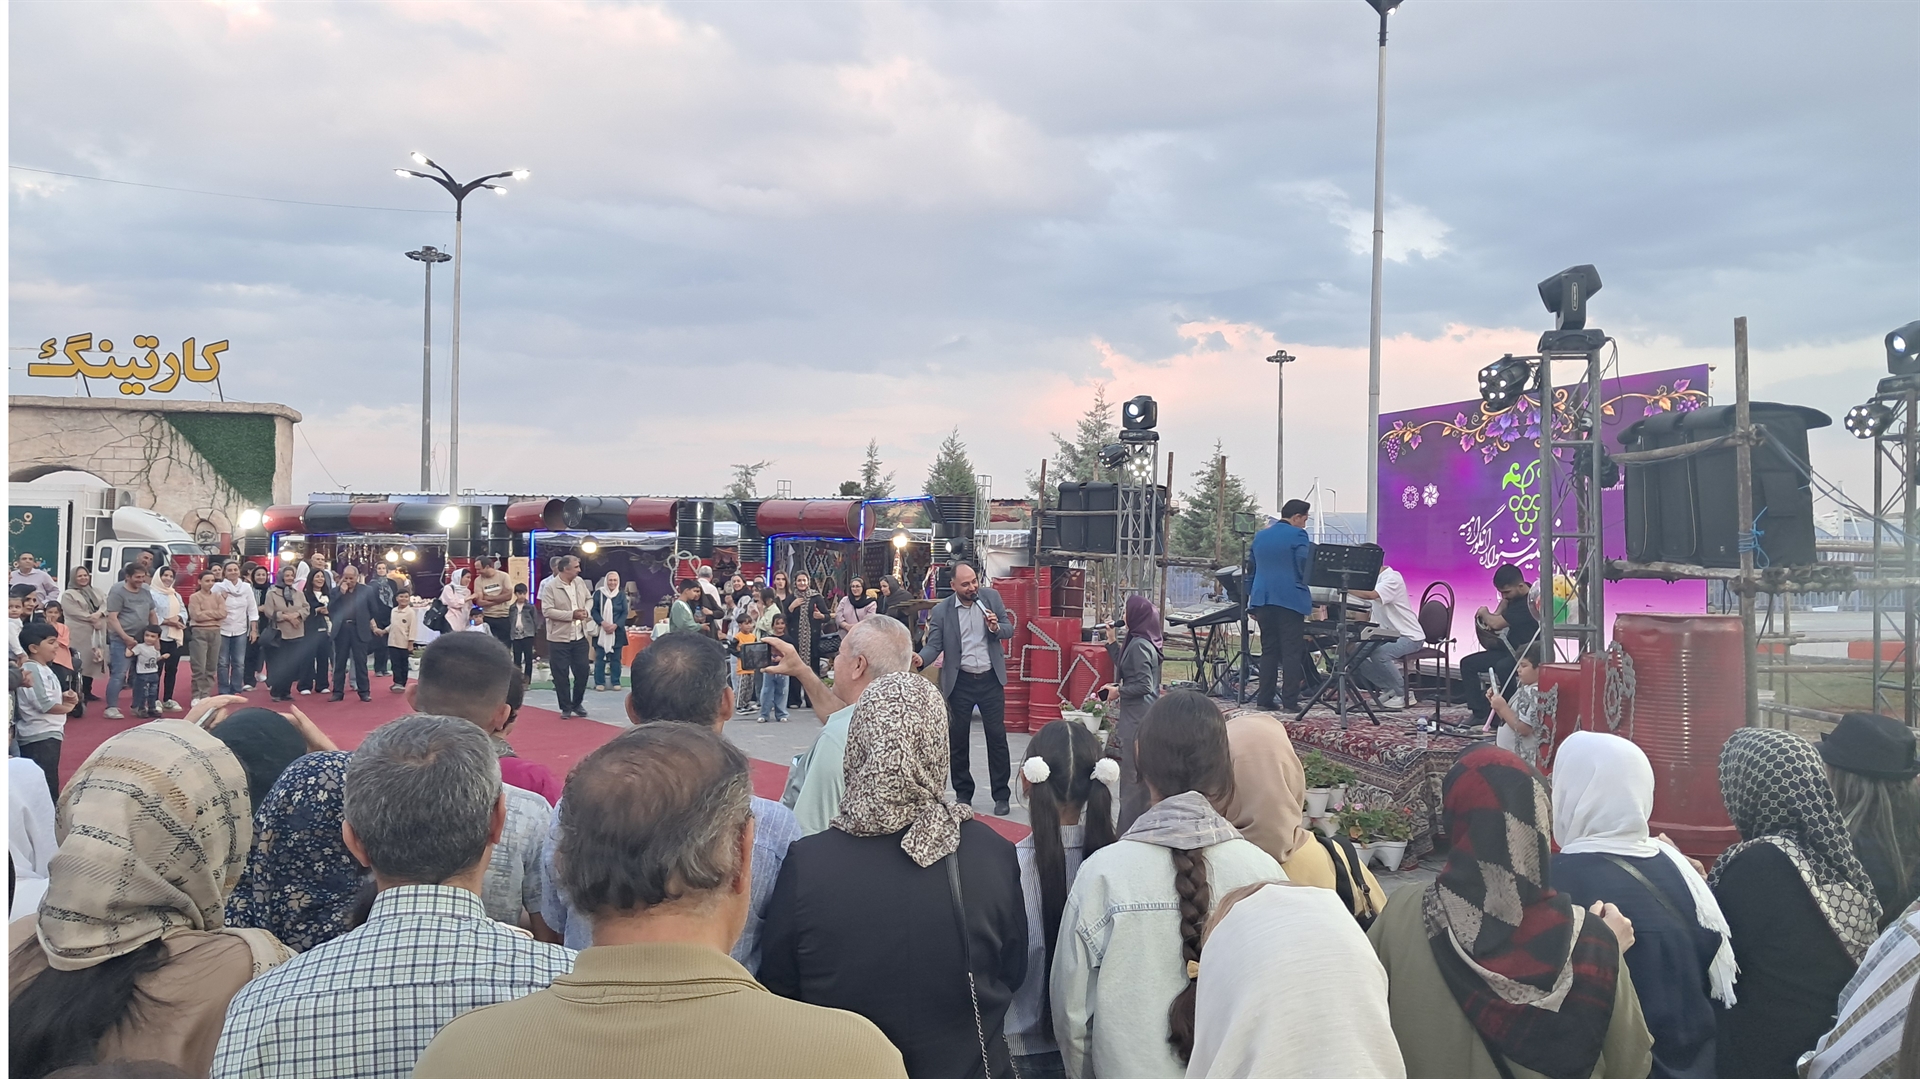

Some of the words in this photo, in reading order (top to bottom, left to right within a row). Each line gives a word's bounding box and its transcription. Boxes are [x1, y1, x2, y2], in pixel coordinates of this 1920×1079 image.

[28, 332, 229, 395] کارتینگ
[1458, 515, 1481, 545] ارومیه
[1469, 503, 1507, 555] انگور
[1479, 532, 1538, 569] جشنواره
